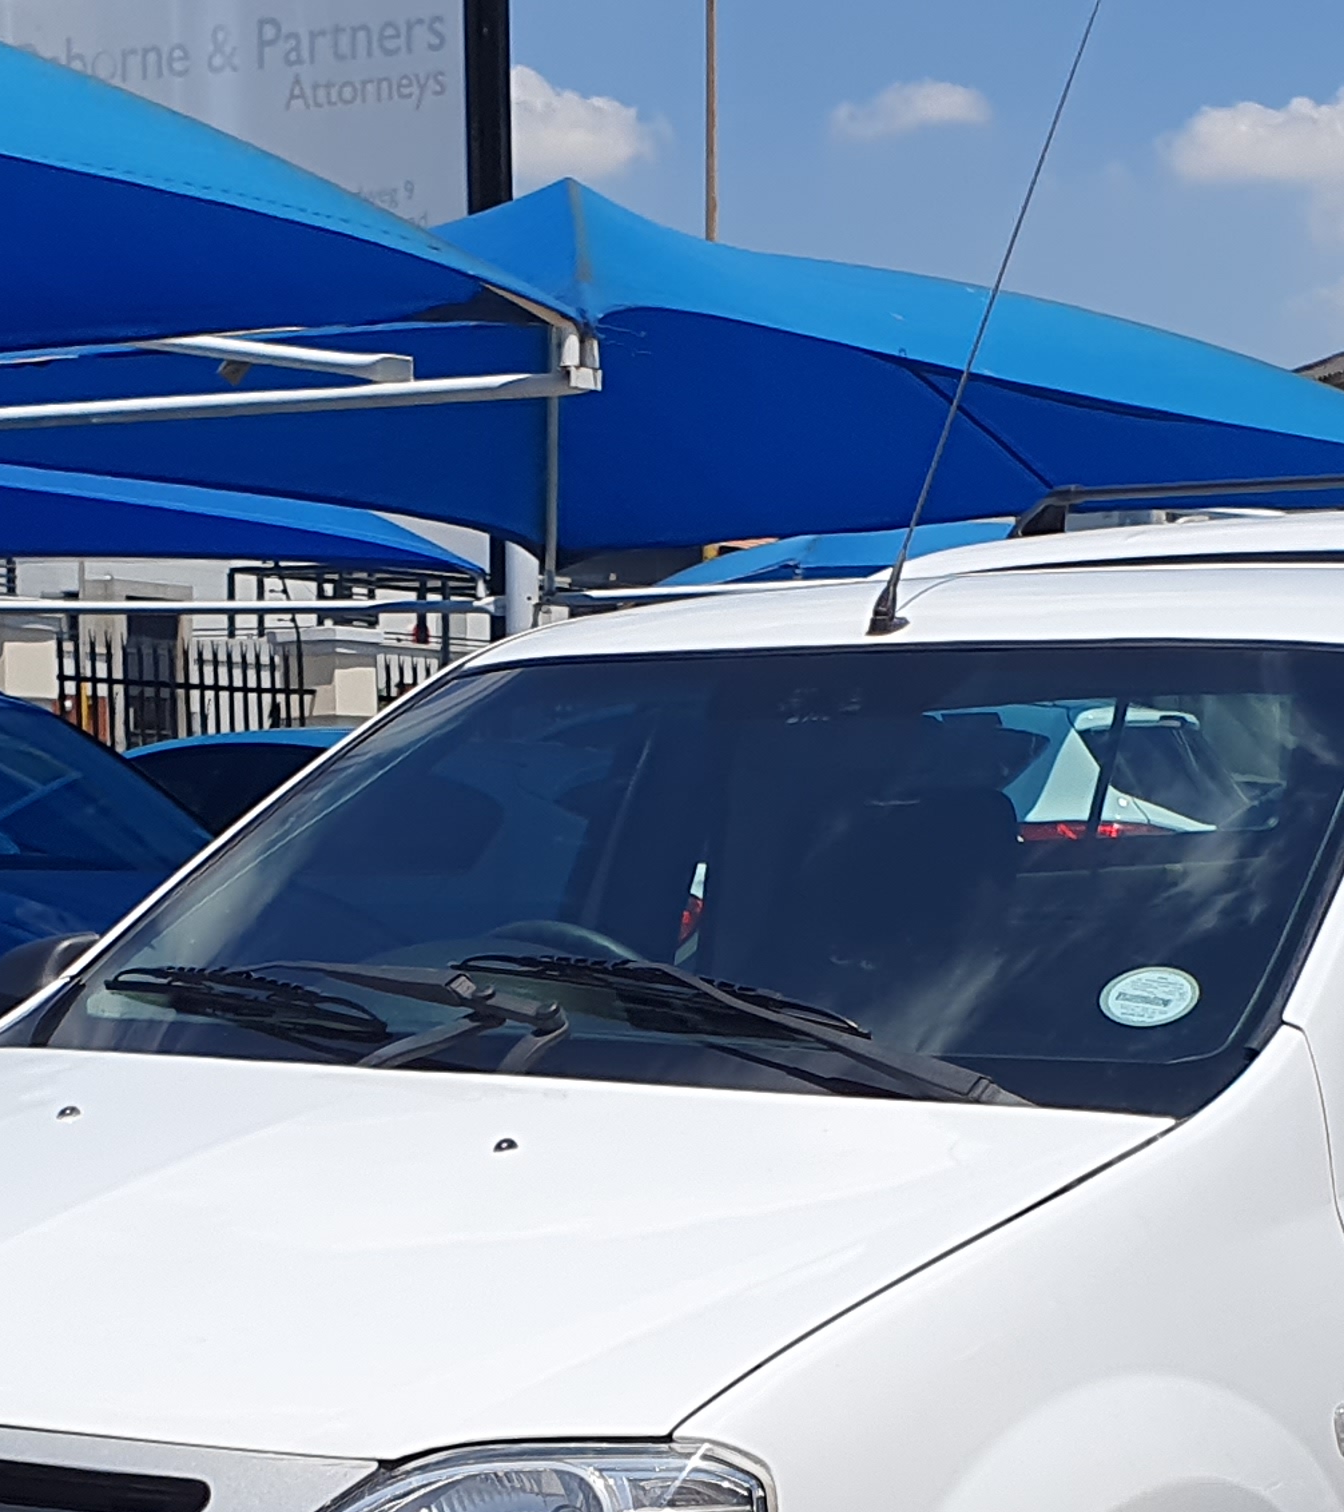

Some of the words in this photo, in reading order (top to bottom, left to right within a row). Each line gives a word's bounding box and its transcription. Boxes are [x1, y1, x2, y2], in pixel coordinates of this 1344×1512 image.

[12, 36, 190, 84] borne
[207, 23, 239, 75] &
[256, 15, 447, 70] Partners
[285, 69, 448, 112] Attorneys
